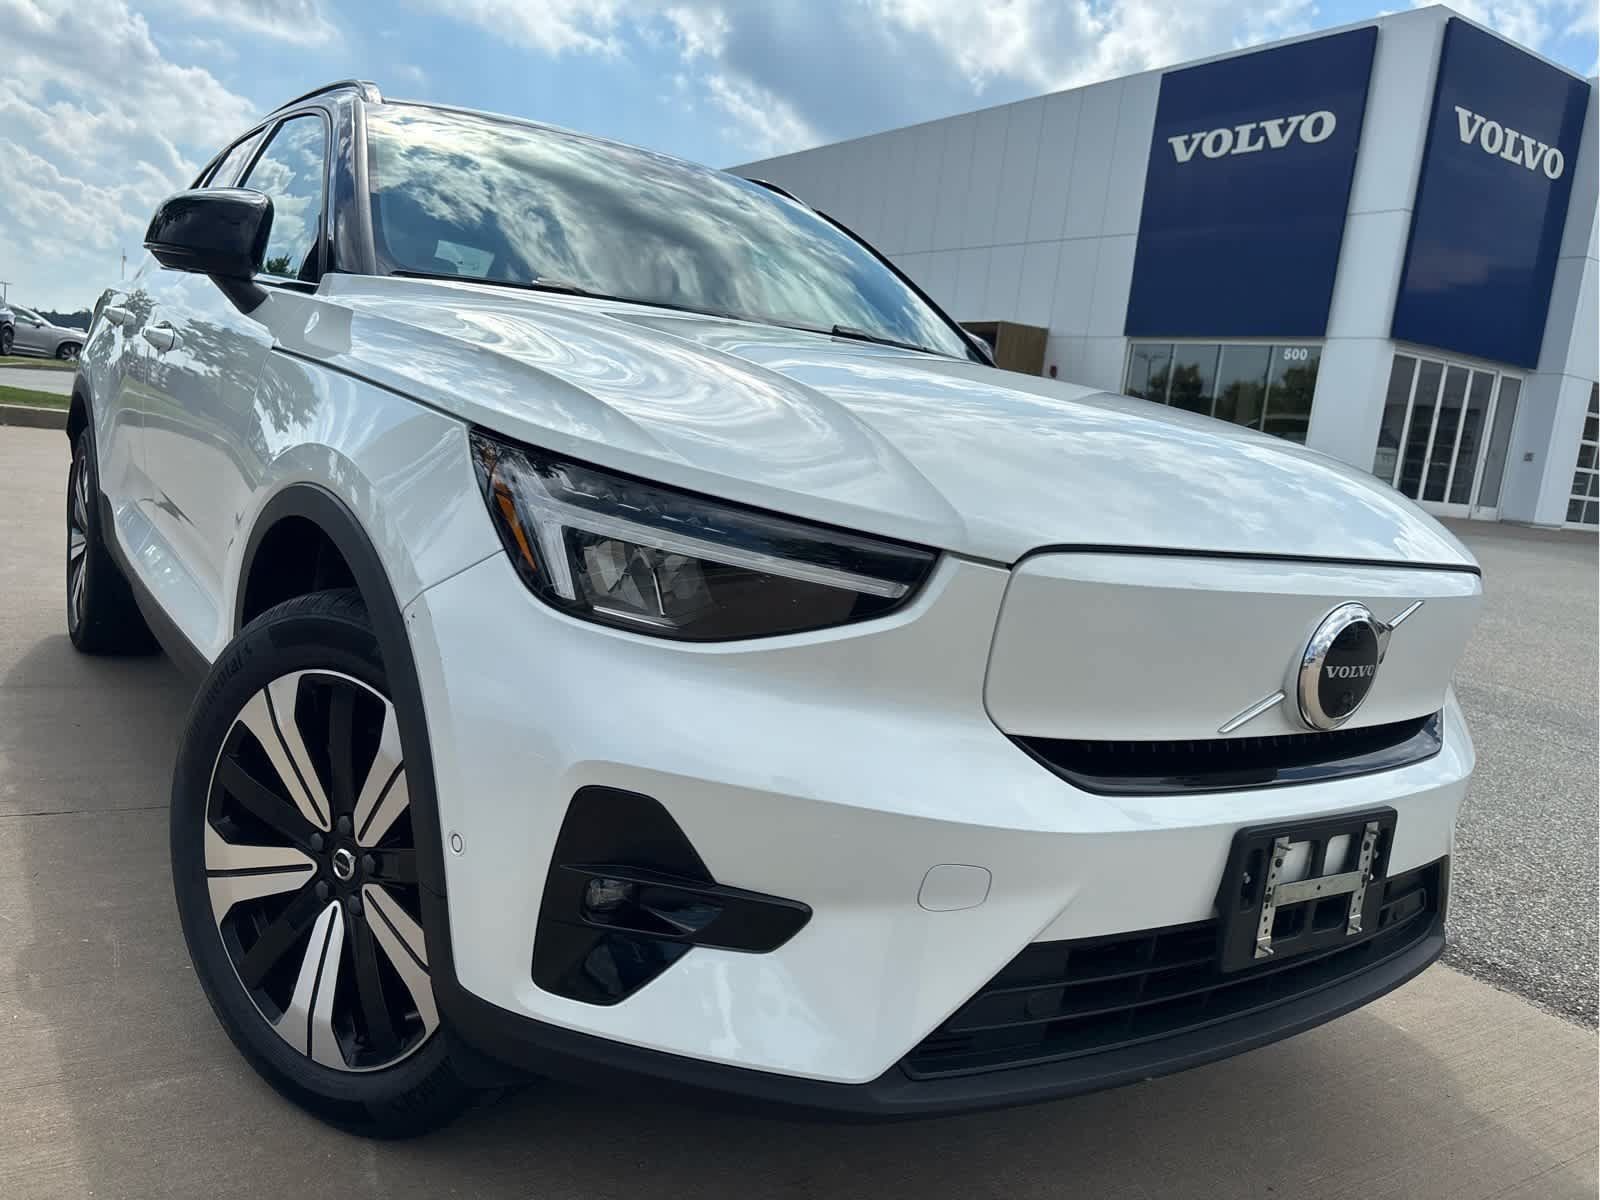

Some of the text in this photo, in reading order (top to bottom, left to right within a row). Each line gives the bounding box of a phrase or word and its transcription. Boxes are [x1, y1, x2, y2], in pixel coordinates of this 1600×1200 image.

[1168, 110, 1337, 163] VOLVO
[1454, 105, 1565, 180] VOLVO
[1283, 347, 1308, 361] 500
[1326, 664, 1375, 679] VOLVO
